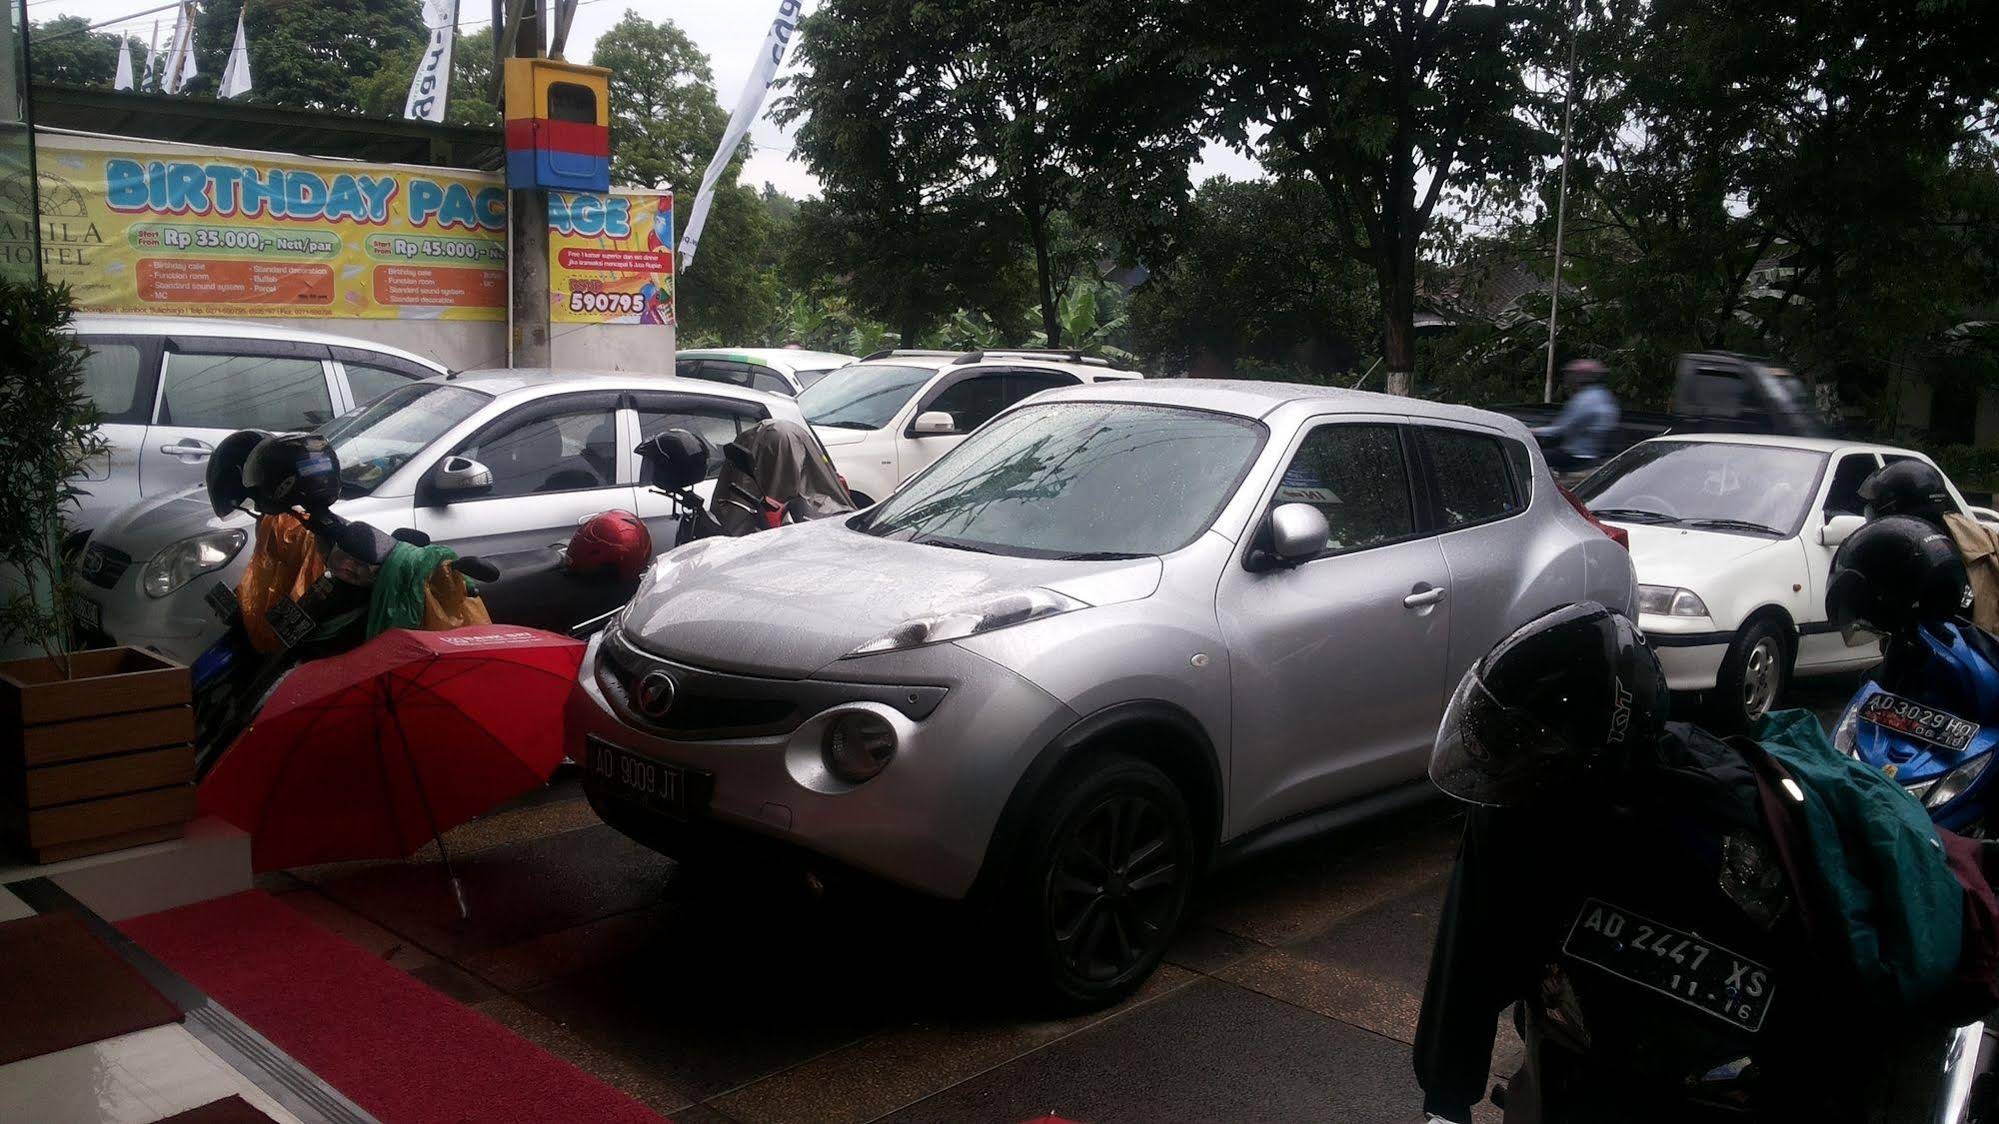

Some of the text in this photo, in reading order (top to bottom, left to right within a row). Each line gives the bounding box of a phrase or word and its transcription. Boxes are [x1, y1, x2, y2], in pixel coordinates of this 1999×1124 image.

[106, 159, 632, 239] BIRTHDAY PACAGE
[138, 230, 159, 238] Start
[164, 228, 333, 254] Rp 35.000,- Nett/pax
[373, 240, 391, 248] Start
[394, 239, 419, 258] Rp
[421, 241, 488, 260] 45.000,-
[153, 261, 187, 272] Birthday
[253, 265, 287, 274] Standard
[154, 271, 188, 279] Function
[155, 281, 191, 290] Standard
[388, 277, 418, 285] Function
[154, 291, 168, 299] MC
[389, 287, 419, 295] Standard
[570, 291, 646, 313] 590795
[1867, 695, 1894, 710] AD
[1894, 702, 1945, 728] 3029
[620, 756, 656, 793] 9009
[1584, 907, 1767, 998] AD 2447 XS
